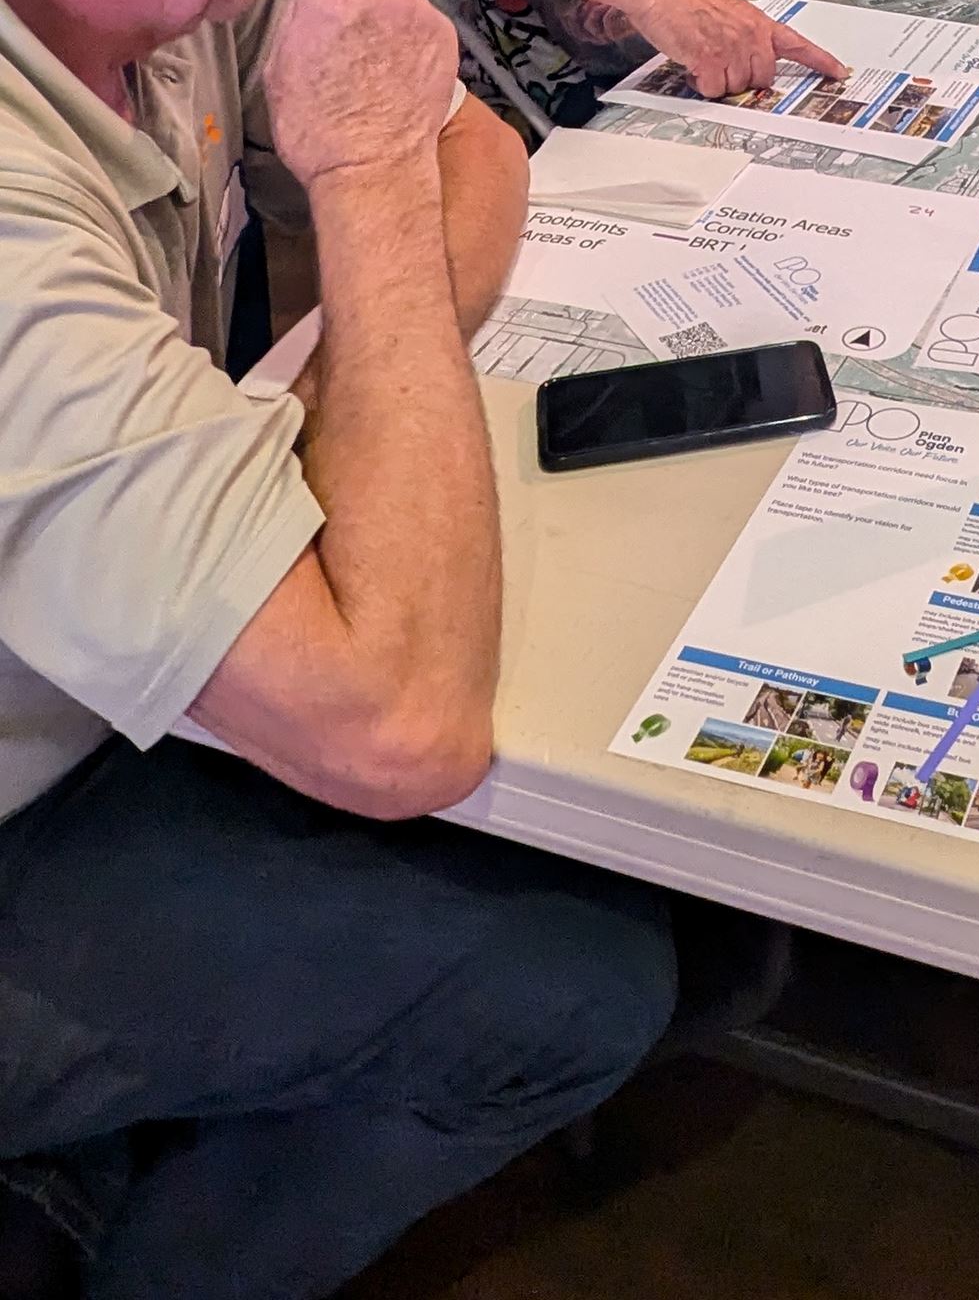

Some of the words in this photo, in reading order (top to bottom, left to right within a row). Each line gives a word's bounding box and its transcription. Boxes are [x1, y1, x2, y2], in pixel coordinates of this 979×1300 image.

[527, 211, 629, 238] Footprints
[703, 221, 785, 243] Corrido
[714, 206, 788, 230] Station
[789, 218, 854, 239] Areas
[519, 230, 577, 249] Areas
[579, 237, 607, 251] of
[687, 235, 736, 254] BRT
[914, 438, 965, 455] Ogden
[918, 429, 953, 444] Plan
[845, 438, 867, 449] Our
[869, 441, 897, 454] Voice
[899, 449, 922, 458] Our
[921, 450, 960, 464] Future
[797, 458, 810, 466] the
[810, 459, 840, 471] future?
[801, 451, 823, 461] What
[822, 453, 877, 470] transportation
[877, 463, 914, 477] corridors
[914, 470, 936, 481] need
[935, 474, 959, 485] focus
[959, 478, 968, 487] in
[781, 483, 797, 492] you
[797, 484, 813, 494] like
[813, 487, 823, 495] to
[823, 489, 843, 499] see?
[786, 474, 808, 485] What
[808, 477, 830, 490] types
[830, 481, 841, 489] of
[841, 484, 898, 502] transportation
[898, 495, 935, 508] corridors
[935, 502, 962, 513] would
[771, 499, 794, 509] Place
[794, 503, 815, 515] tape
[814, 507, 823, 515] to
[823, 508, 854, 523] identify
[854, 514, 874, 525] your
[874, 518, 899, 530] vision
[899, 523, 914, 532] for
[738, 659, 761, 673] Trail
[761, 666, 774, 676] or
[774, 668, 821, 688] Pathway
[947, 707, 960, 718] Bu
